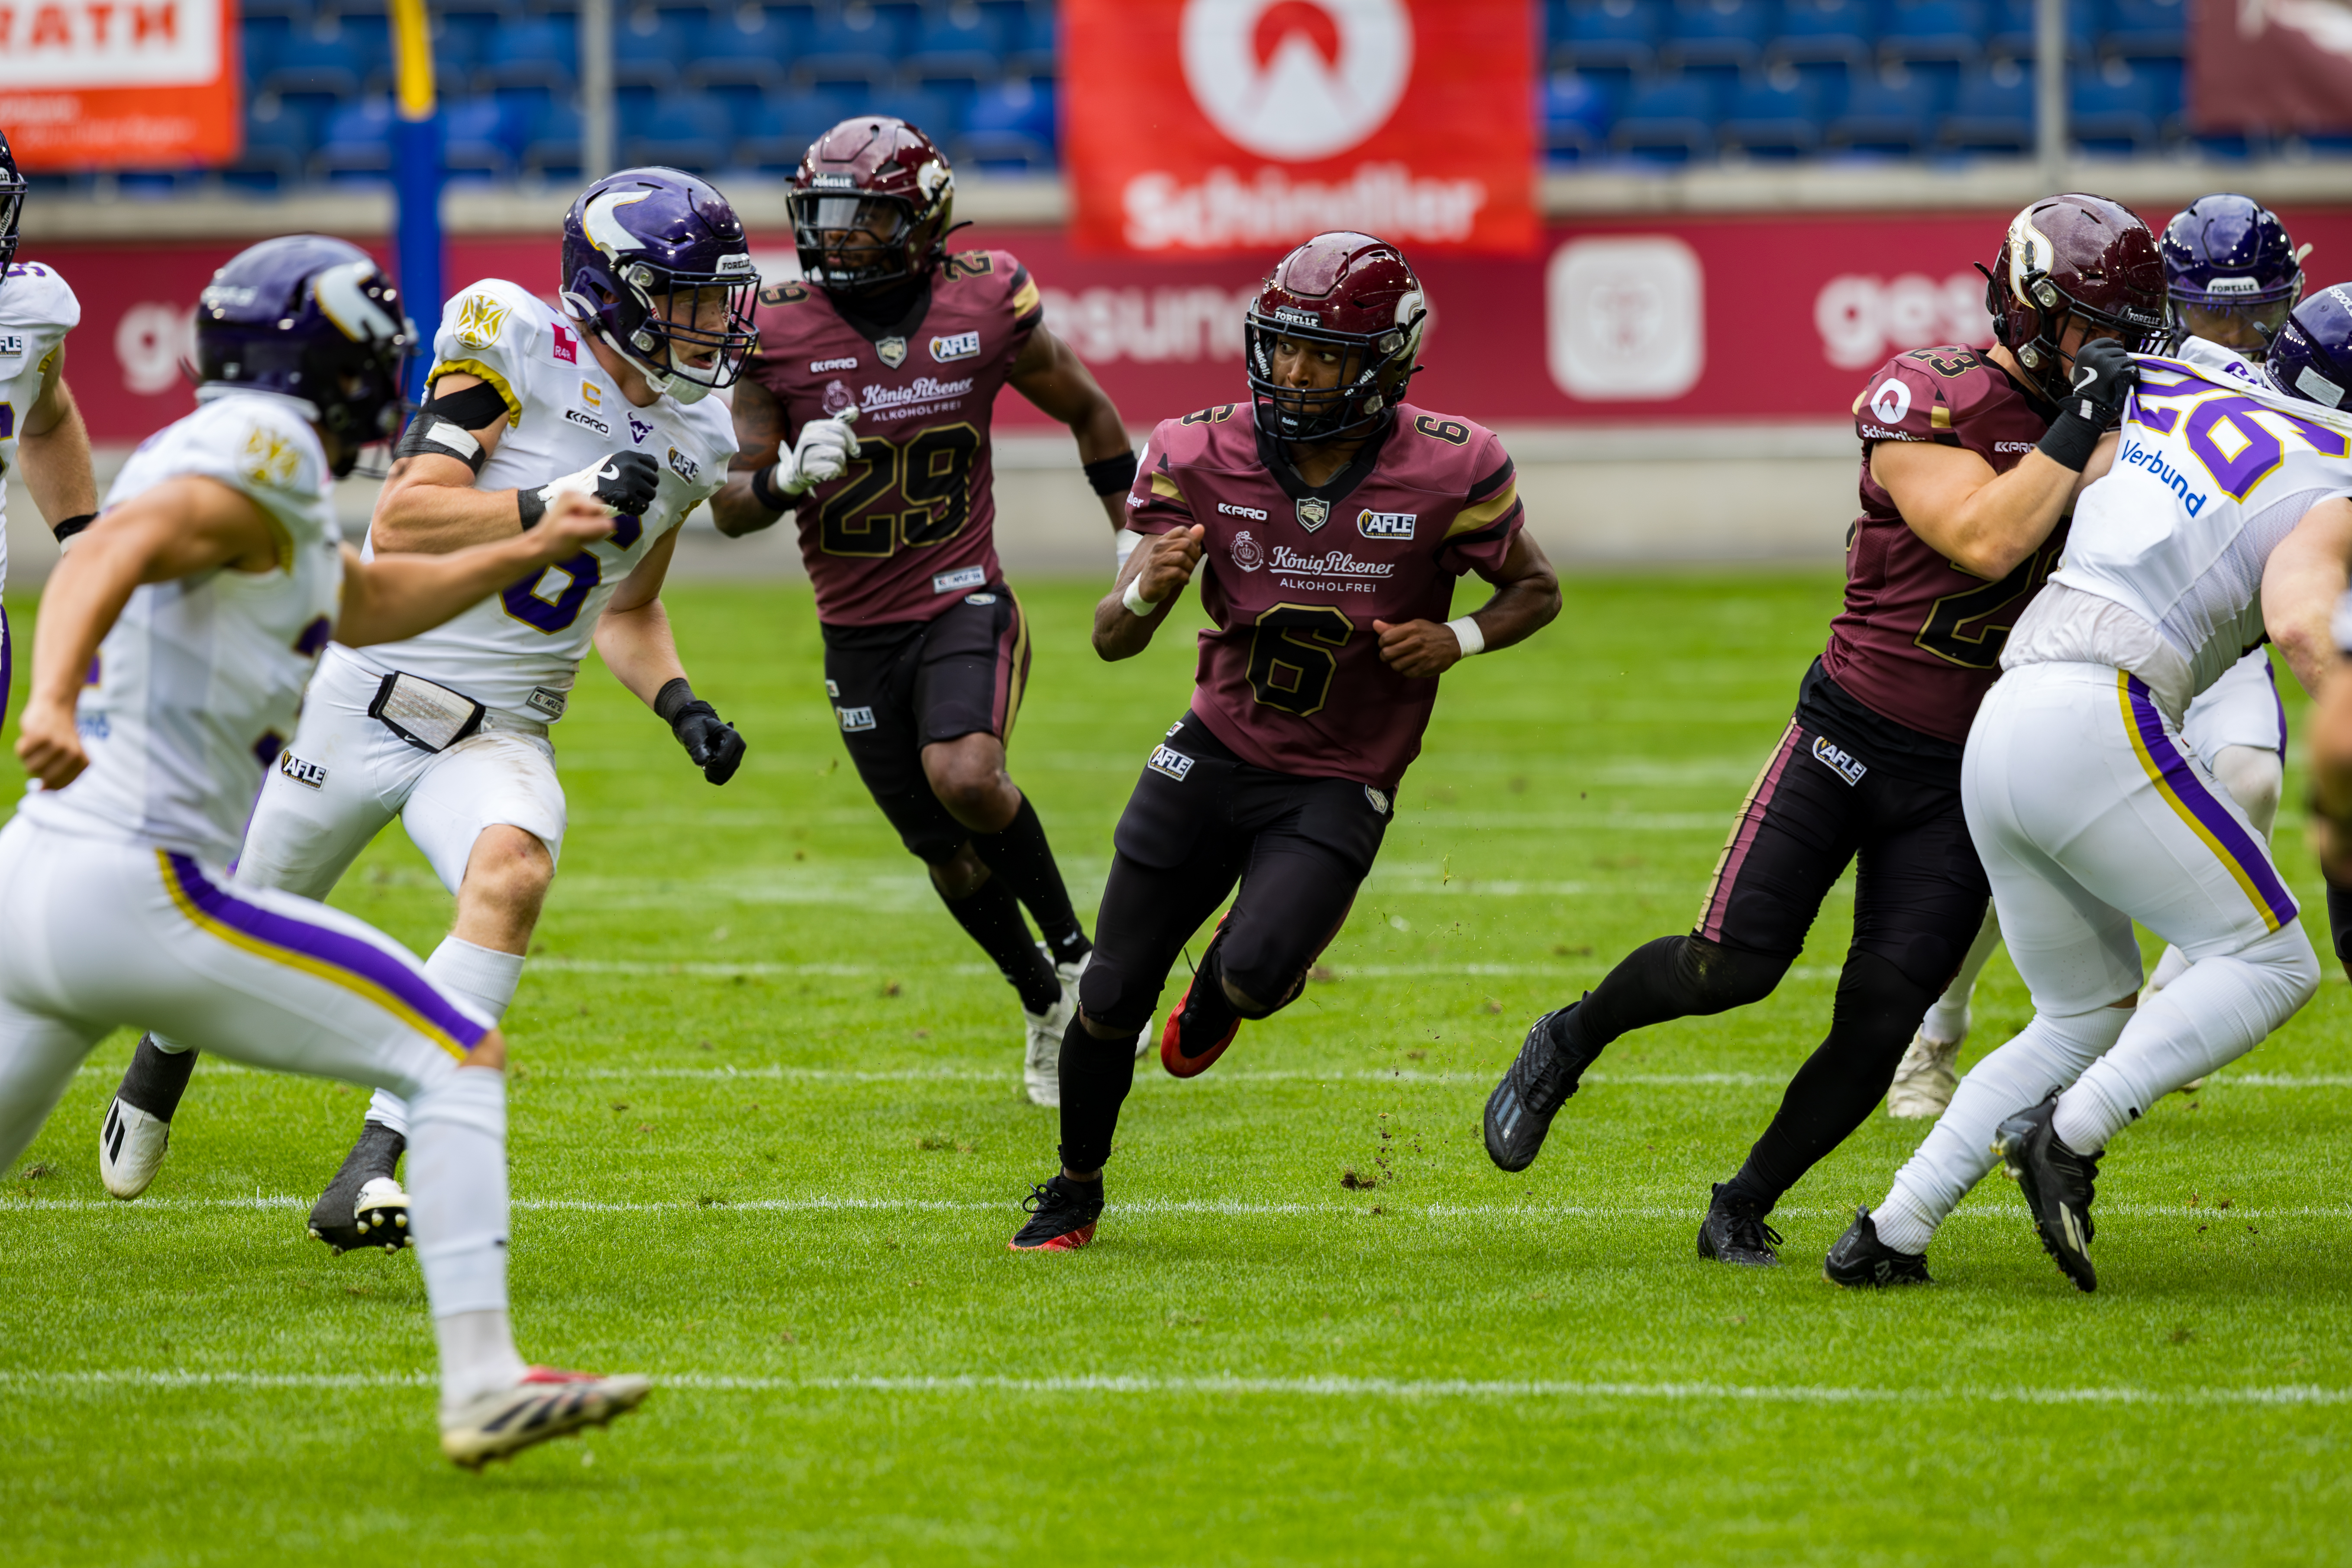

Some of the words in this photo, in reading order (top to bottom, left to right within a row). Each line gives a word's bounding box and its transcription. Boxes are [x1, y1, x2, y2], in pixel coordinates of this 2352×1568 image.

[1125, 163, 1486, 250] Schindler
[940, 249, 994, 283] 2
[1275, 311, 1318, 327] FORELLE
[1814, 273, 1992, 372] ges
[2129, 312, 2161, 325] FORELLE
[0, 337, 21, 351] FLE
[939, 335, 976, 358] AFLE
[1905, 347, 1983, 378] 23
[872, 400, 961, 423] ALKOHOLFREI
[672, 453, 699, 481] AFLE
[2122, 439, 2207, 519] Verbund
[819, 421, 981, 559] 29
[1367, 514, 1413, 533] AFLE
[1280, 577, 1376, 592] ALKOHOLFREI
[1245, 601, 1356, 718] 6
[283, 757, 326, 785] AFLE
[1151, 748, 1191, 775] AFLE
[1819, 744, 1863, 780] AFLE
